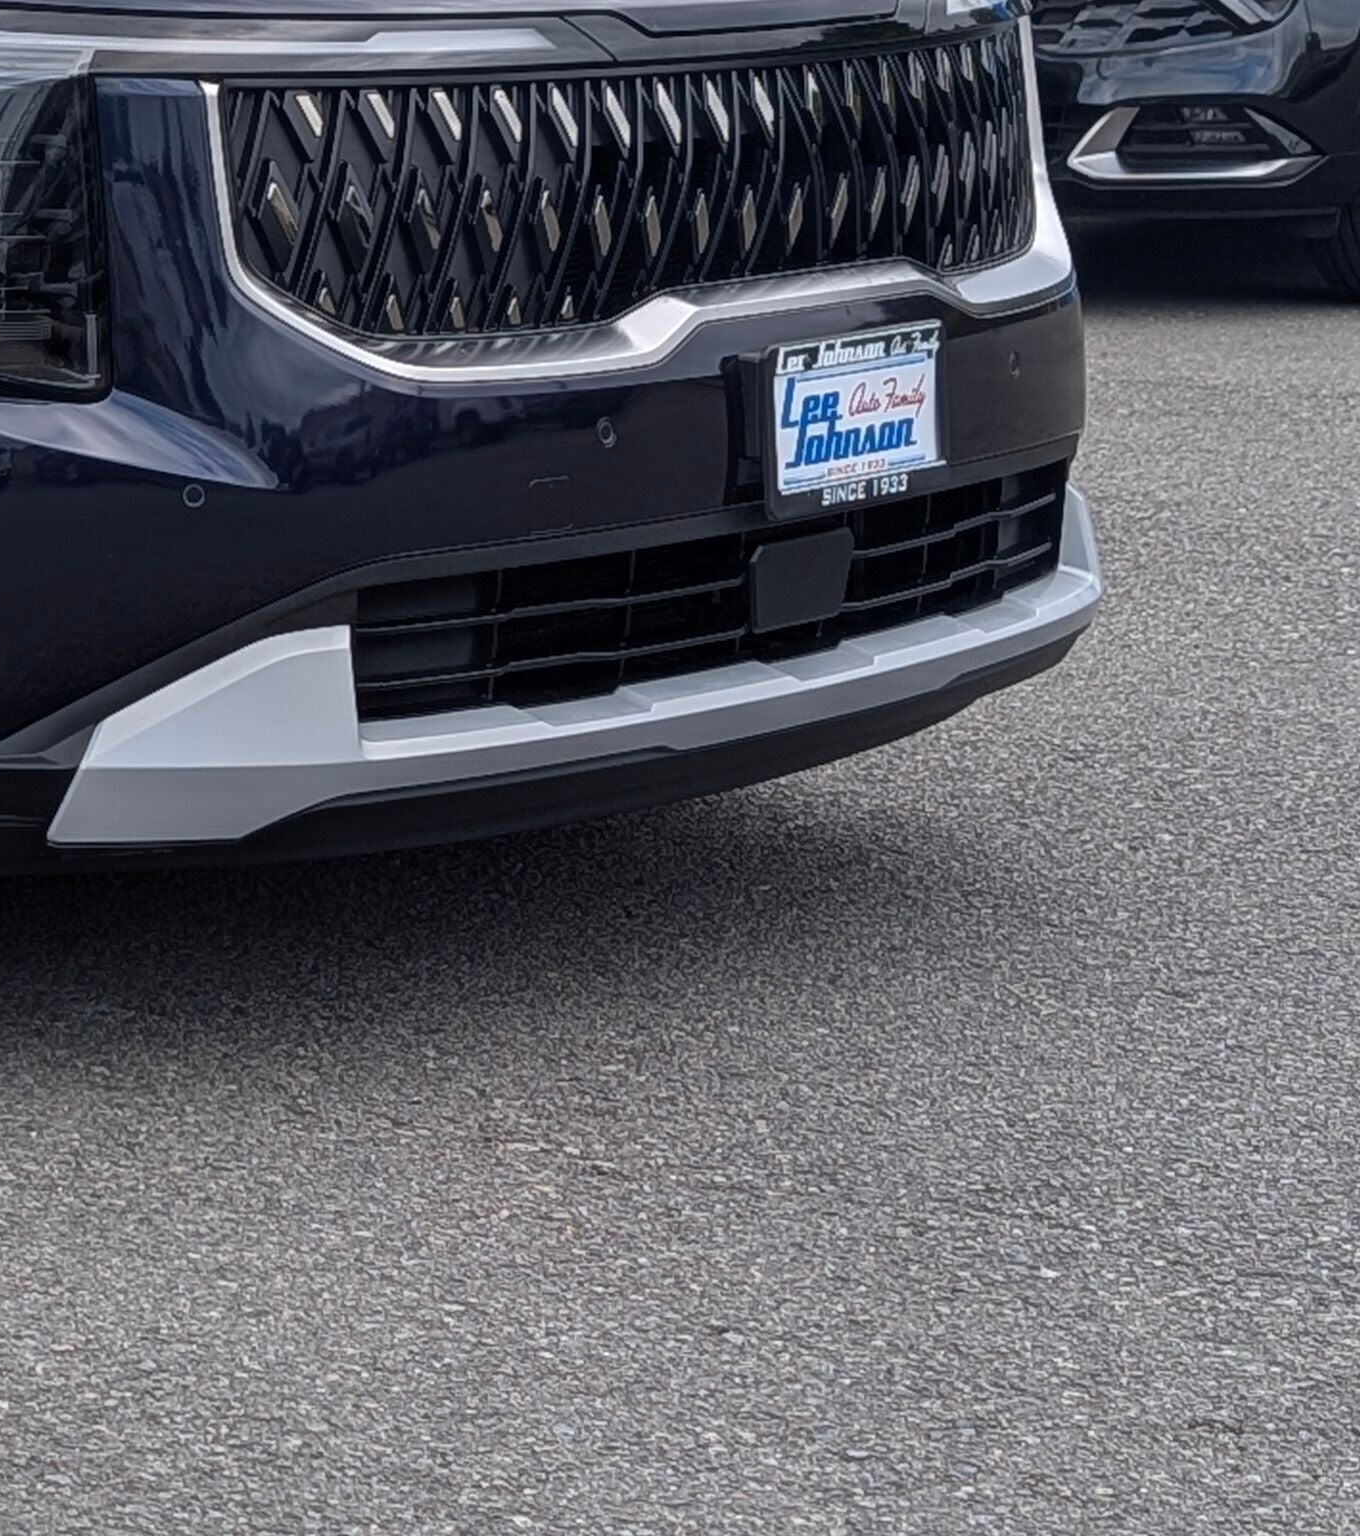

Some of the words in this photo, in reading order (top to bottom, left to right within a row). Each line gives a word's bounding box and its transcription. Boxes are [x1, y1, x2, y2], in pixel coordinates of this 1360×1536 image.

[812, 339, 886, 369] Johnson
[781, 376, 843, 429] Lee
[848, 382, 880, 417] Auto
[883, 374, 925, 418] Family
[784, 417, 917, 469] Johnson
[827, 462, 857, 478] SINCE
[861, 458, 885, 472] 1933
[821, 481, 867, 506] SINCE
[873, 473, 908, 497] 1933
